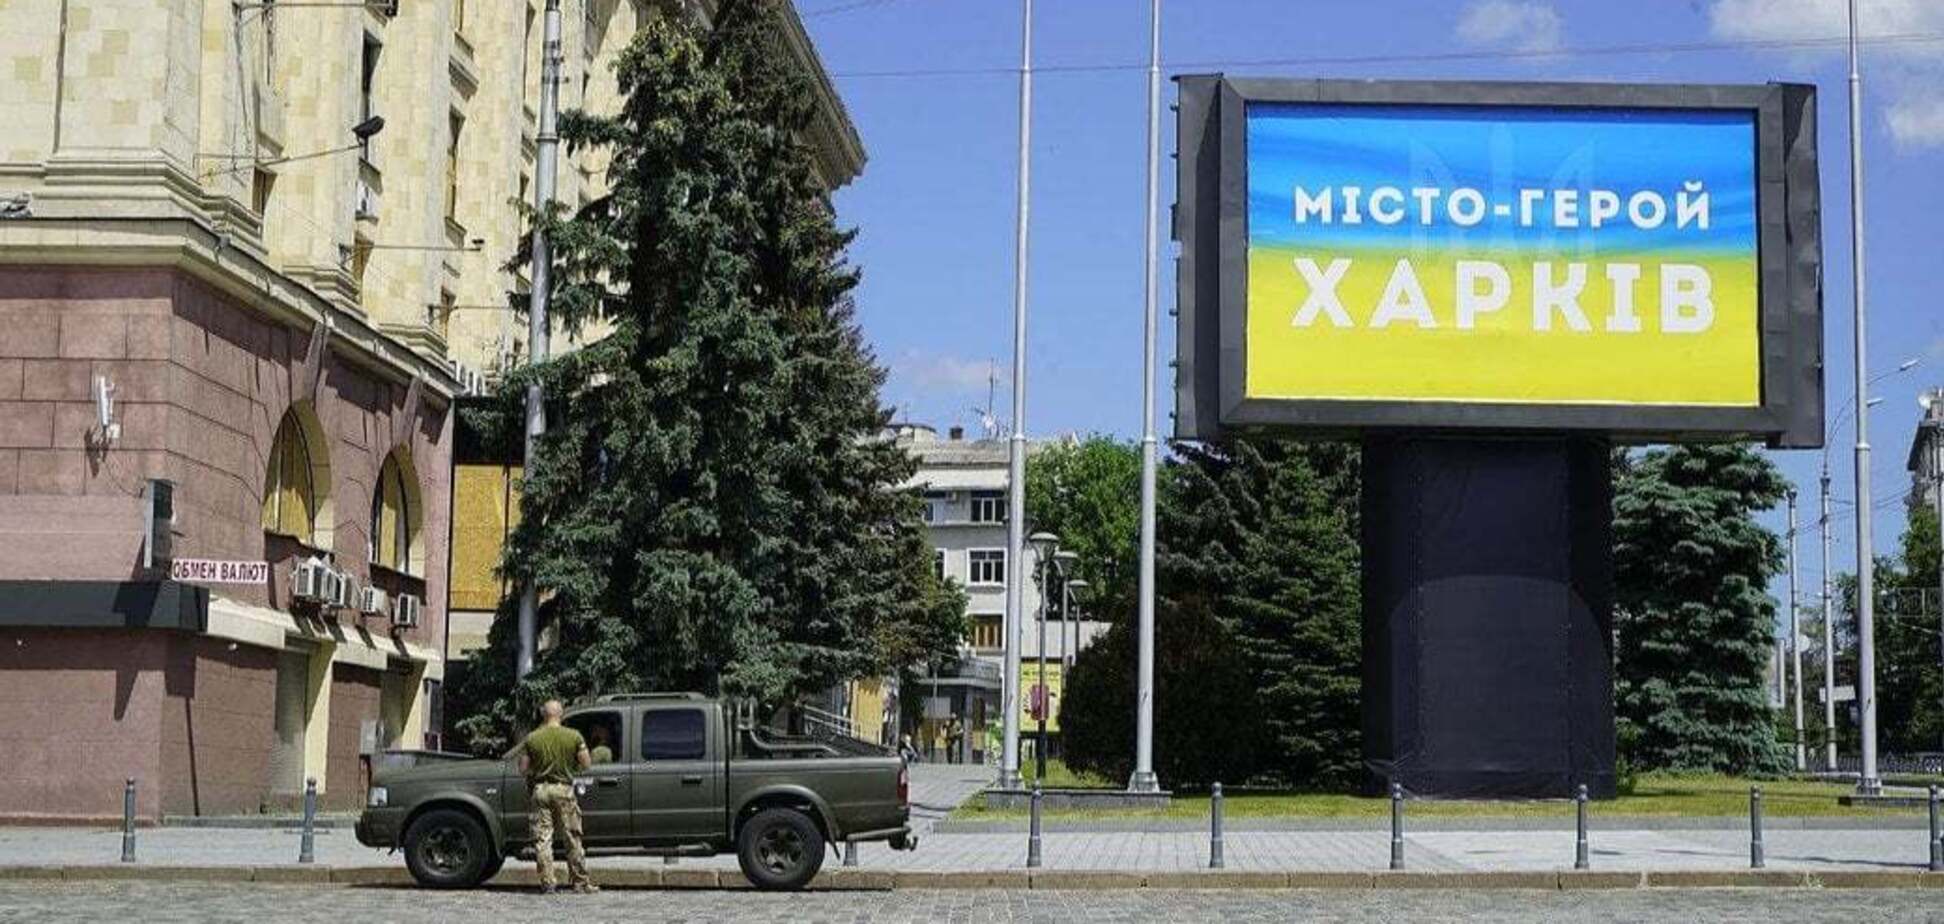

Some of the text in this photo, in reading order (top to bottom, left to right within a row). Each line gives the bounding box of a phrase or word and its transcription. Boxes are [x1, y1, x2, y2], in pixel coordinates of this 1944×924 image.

[1294, 181, 1710, 229] МІСТО-ГЕРОЙ
[1291, 257, 1715, 333] ХАРКІВ
[173, 561, 266, 580] ОБМЕН ВАЛЮТ
